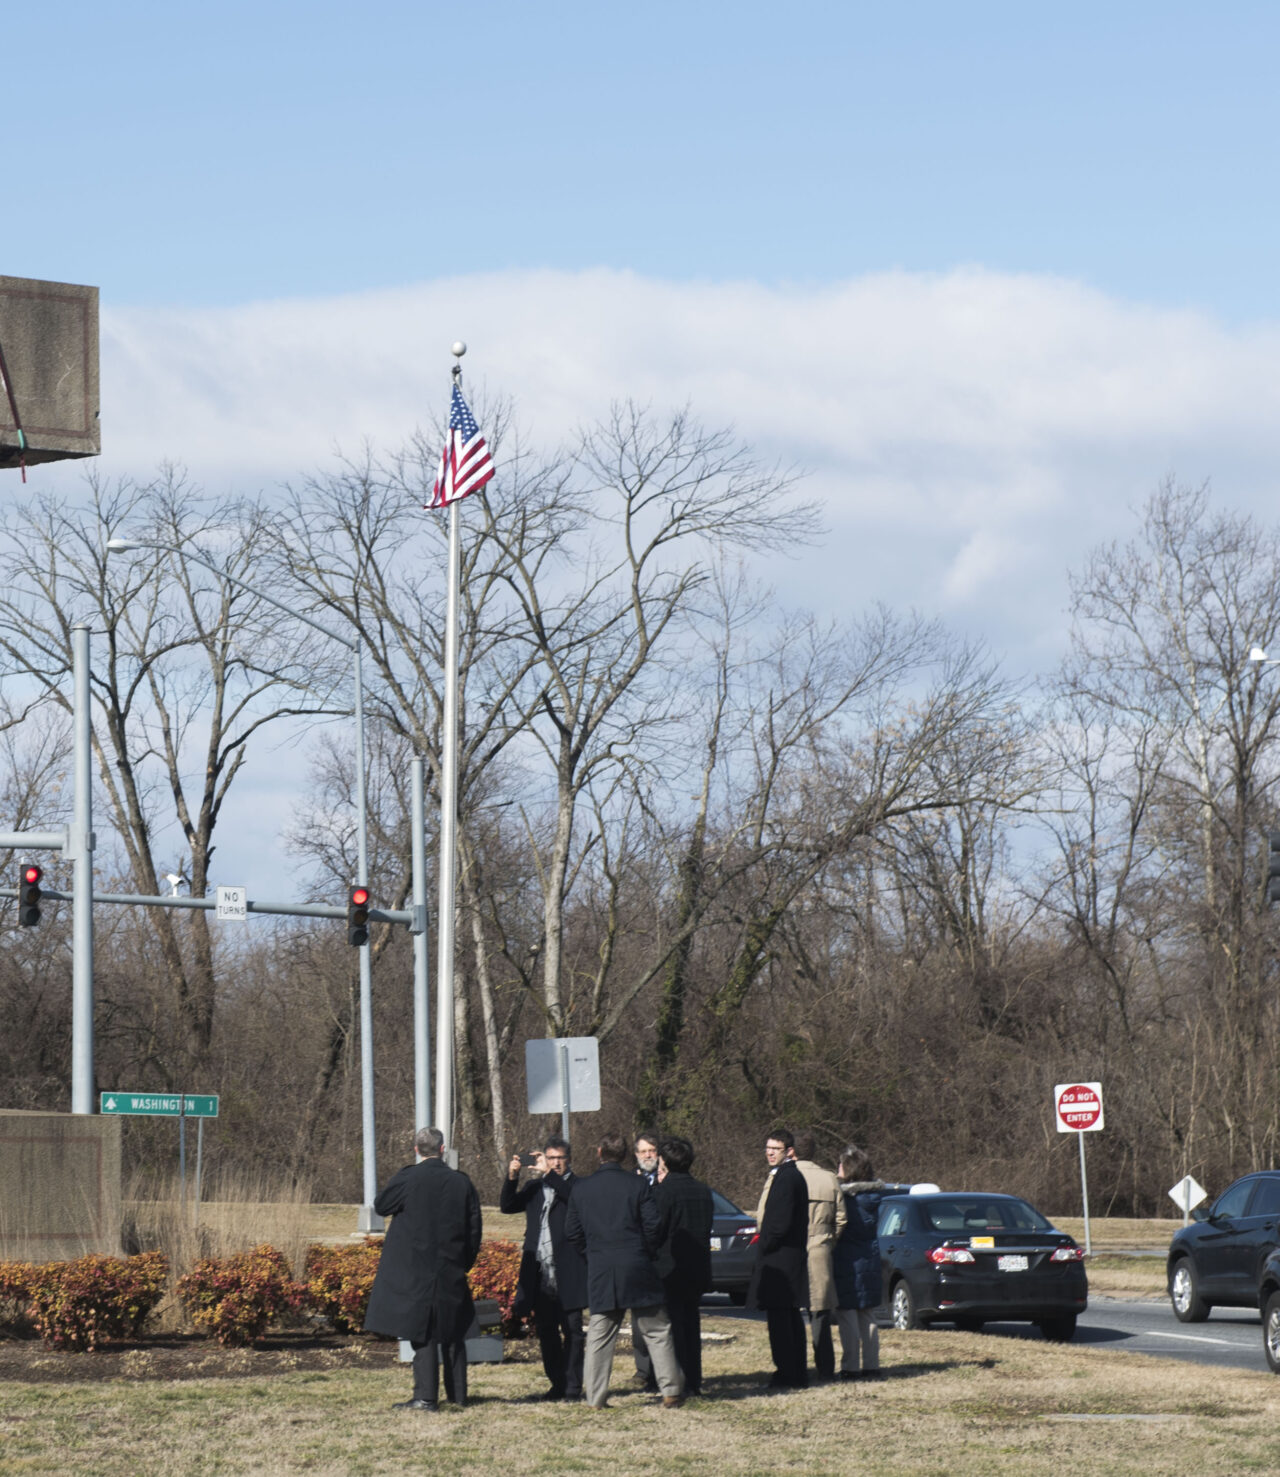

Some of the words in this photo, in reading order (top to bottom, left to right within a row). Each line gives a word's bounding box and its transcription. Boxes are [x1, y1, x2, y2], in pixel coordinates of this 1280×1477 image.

[224, 892, 239, 902] NO
[218, 906, 246, 915] TURNS
[1062, 1094, 1075, 1102] DO
[1077, 1093, 1094, 1101] NOT
[1066, 1113, 1093, 1122] ENTER
